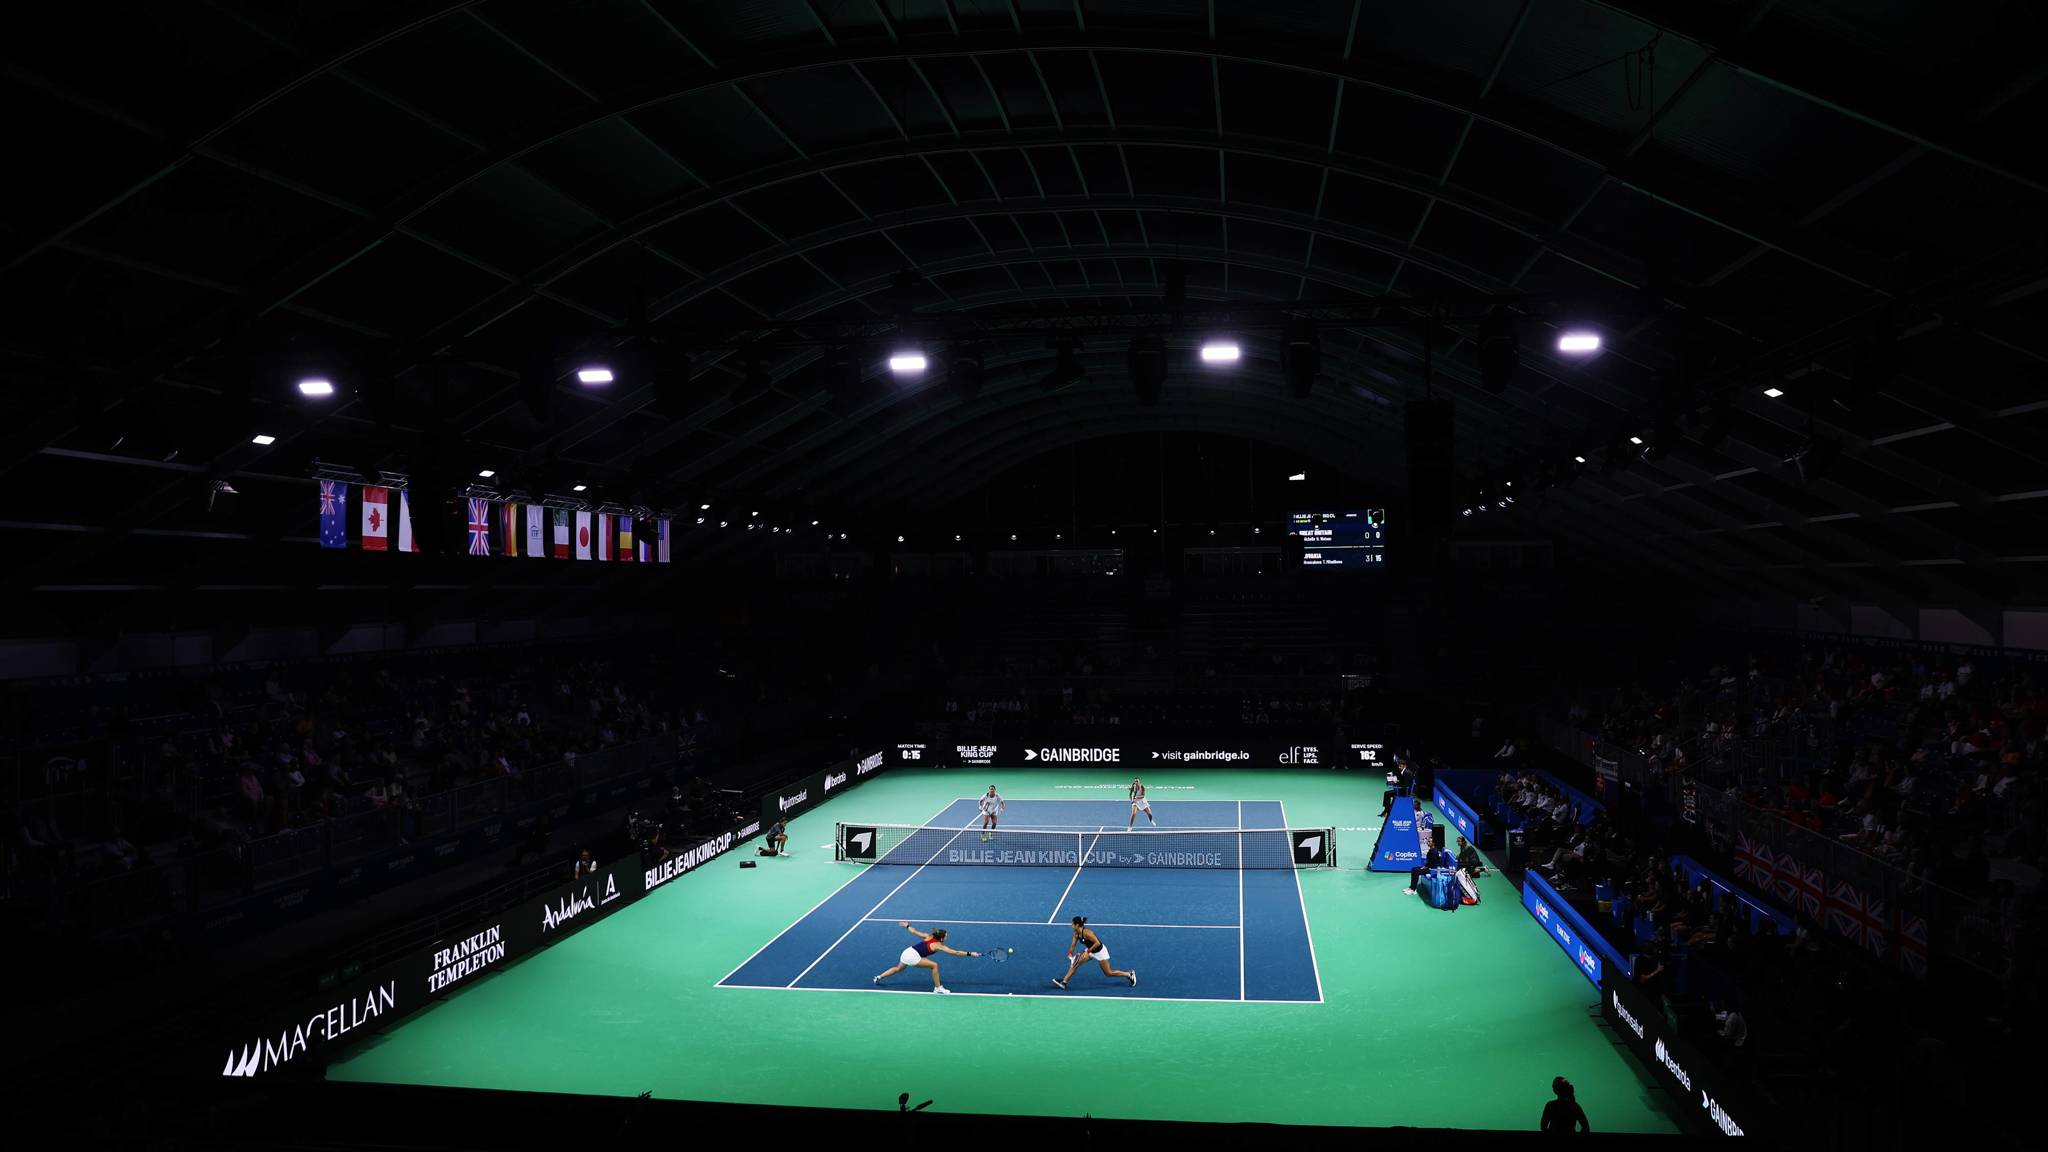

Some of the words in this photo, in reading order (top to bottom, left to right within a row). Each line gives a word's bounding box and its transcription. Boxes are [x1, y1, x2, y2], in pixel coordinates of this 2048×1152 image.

[1364, 531, 1370, 539] 0
[1365, 554, 1370, 562] 3
[902, 750, 921, 760] 0:15
[1040, 748, 1120, 762] GAINBRIDGE
[1162, 750, 1182, 760] visit
[1183, 750, 1250, 762] gainbridge.io
[1360, 750, 1376, 760] 162
[861, 751, 883, 774] GAINBRIDGE
[645, 860, 673, 891] BILLIE
[672, 849, 696, 876] JEAN
[696, 839, 716, 864] KING
[716, 831, 732, 853] CUP
[949, 849, 995, 864] BILLIE
[996, 849, 1036, 864] JEAN
[1038, 850, 1080, 865] KING
[1085, 850, 1117, 865] CUP
[1119, 854, 1132, 865] by
[1147, 851, 1222, 867] GAINBRIDGE
[433, 924, 501, 972] FRANKLIN
[427, 940, 506, 993] TEMPLETON
